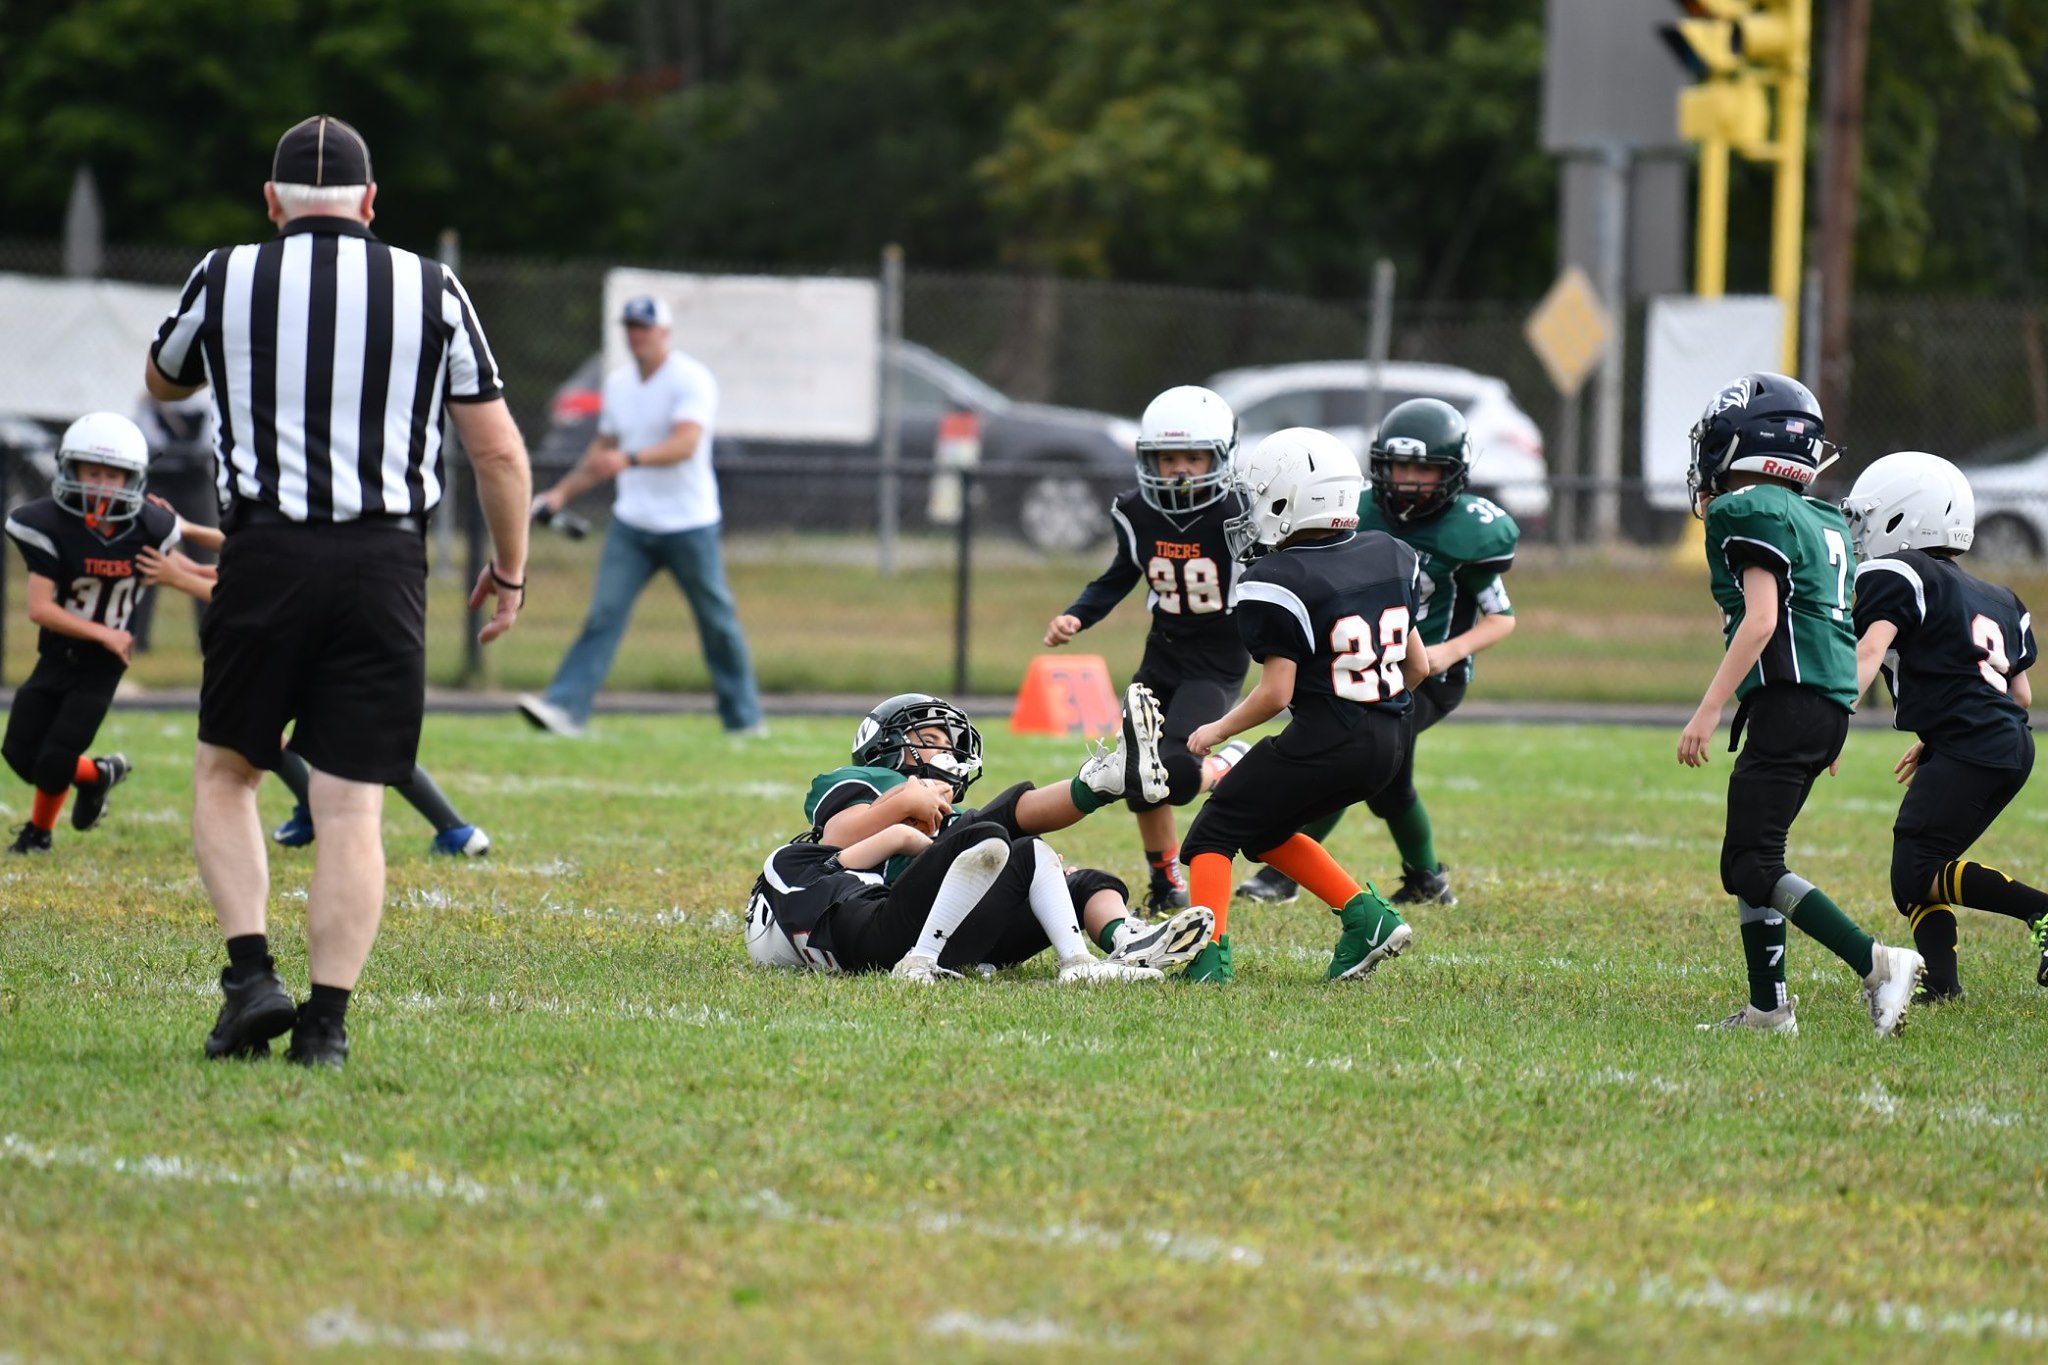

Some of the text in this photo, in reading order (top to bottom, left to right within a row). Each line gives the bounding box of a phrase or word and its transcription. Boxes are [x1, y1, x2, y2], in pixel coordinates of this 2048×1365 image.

[1762, 459, 1815, 484] Riddell
[84, 558, 133, 577] TIGERS
[1155, 541, 1201, 559] TIGERS
[1148, 556, 1223, 615] 28
[1823, 527, 1848, 621] 7
[63, 576, 137, 633] 30
[1329, 605, 1410, 703] 22
[1765, 944, 1784, 967] 7
